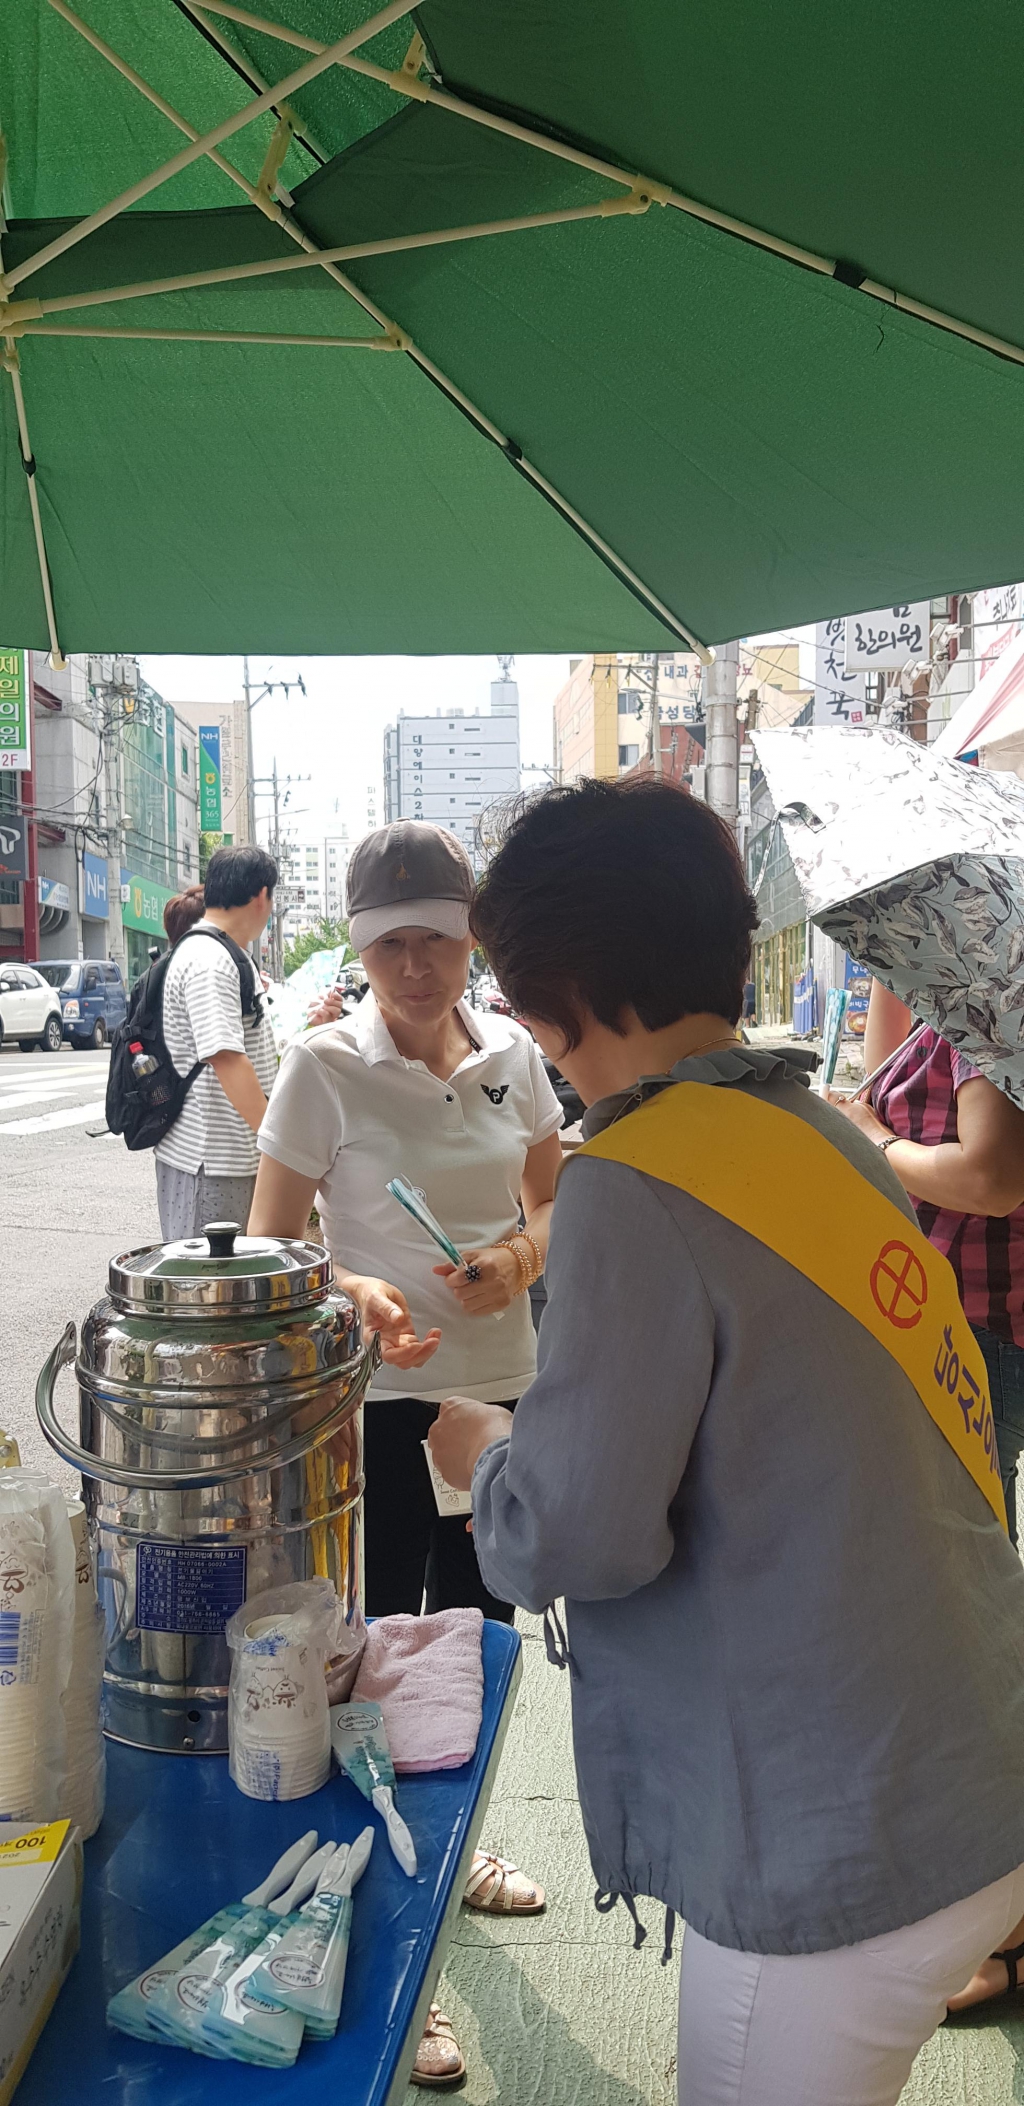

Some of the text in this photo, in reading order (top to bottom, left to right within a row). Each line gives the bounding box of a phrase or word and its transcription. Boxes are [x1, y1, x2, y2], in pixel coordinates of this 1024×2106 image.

[855, 623, 923, 655] 한의원
[201, 732, 218, 741] NH
[2, 753, 18, 767] 2F
[205, 786, 217, 808] 농협
[205, 810, 219, 819] 365
[87, 870, 106, 901] NH
[143, 892, 158, 921] 농협
[492, 1091, 501, 1103] P
[155, 1548, 240, 1560] 전기용품 안전관리법에 의한 표시
[15, 1835, 46, 1849] 100
